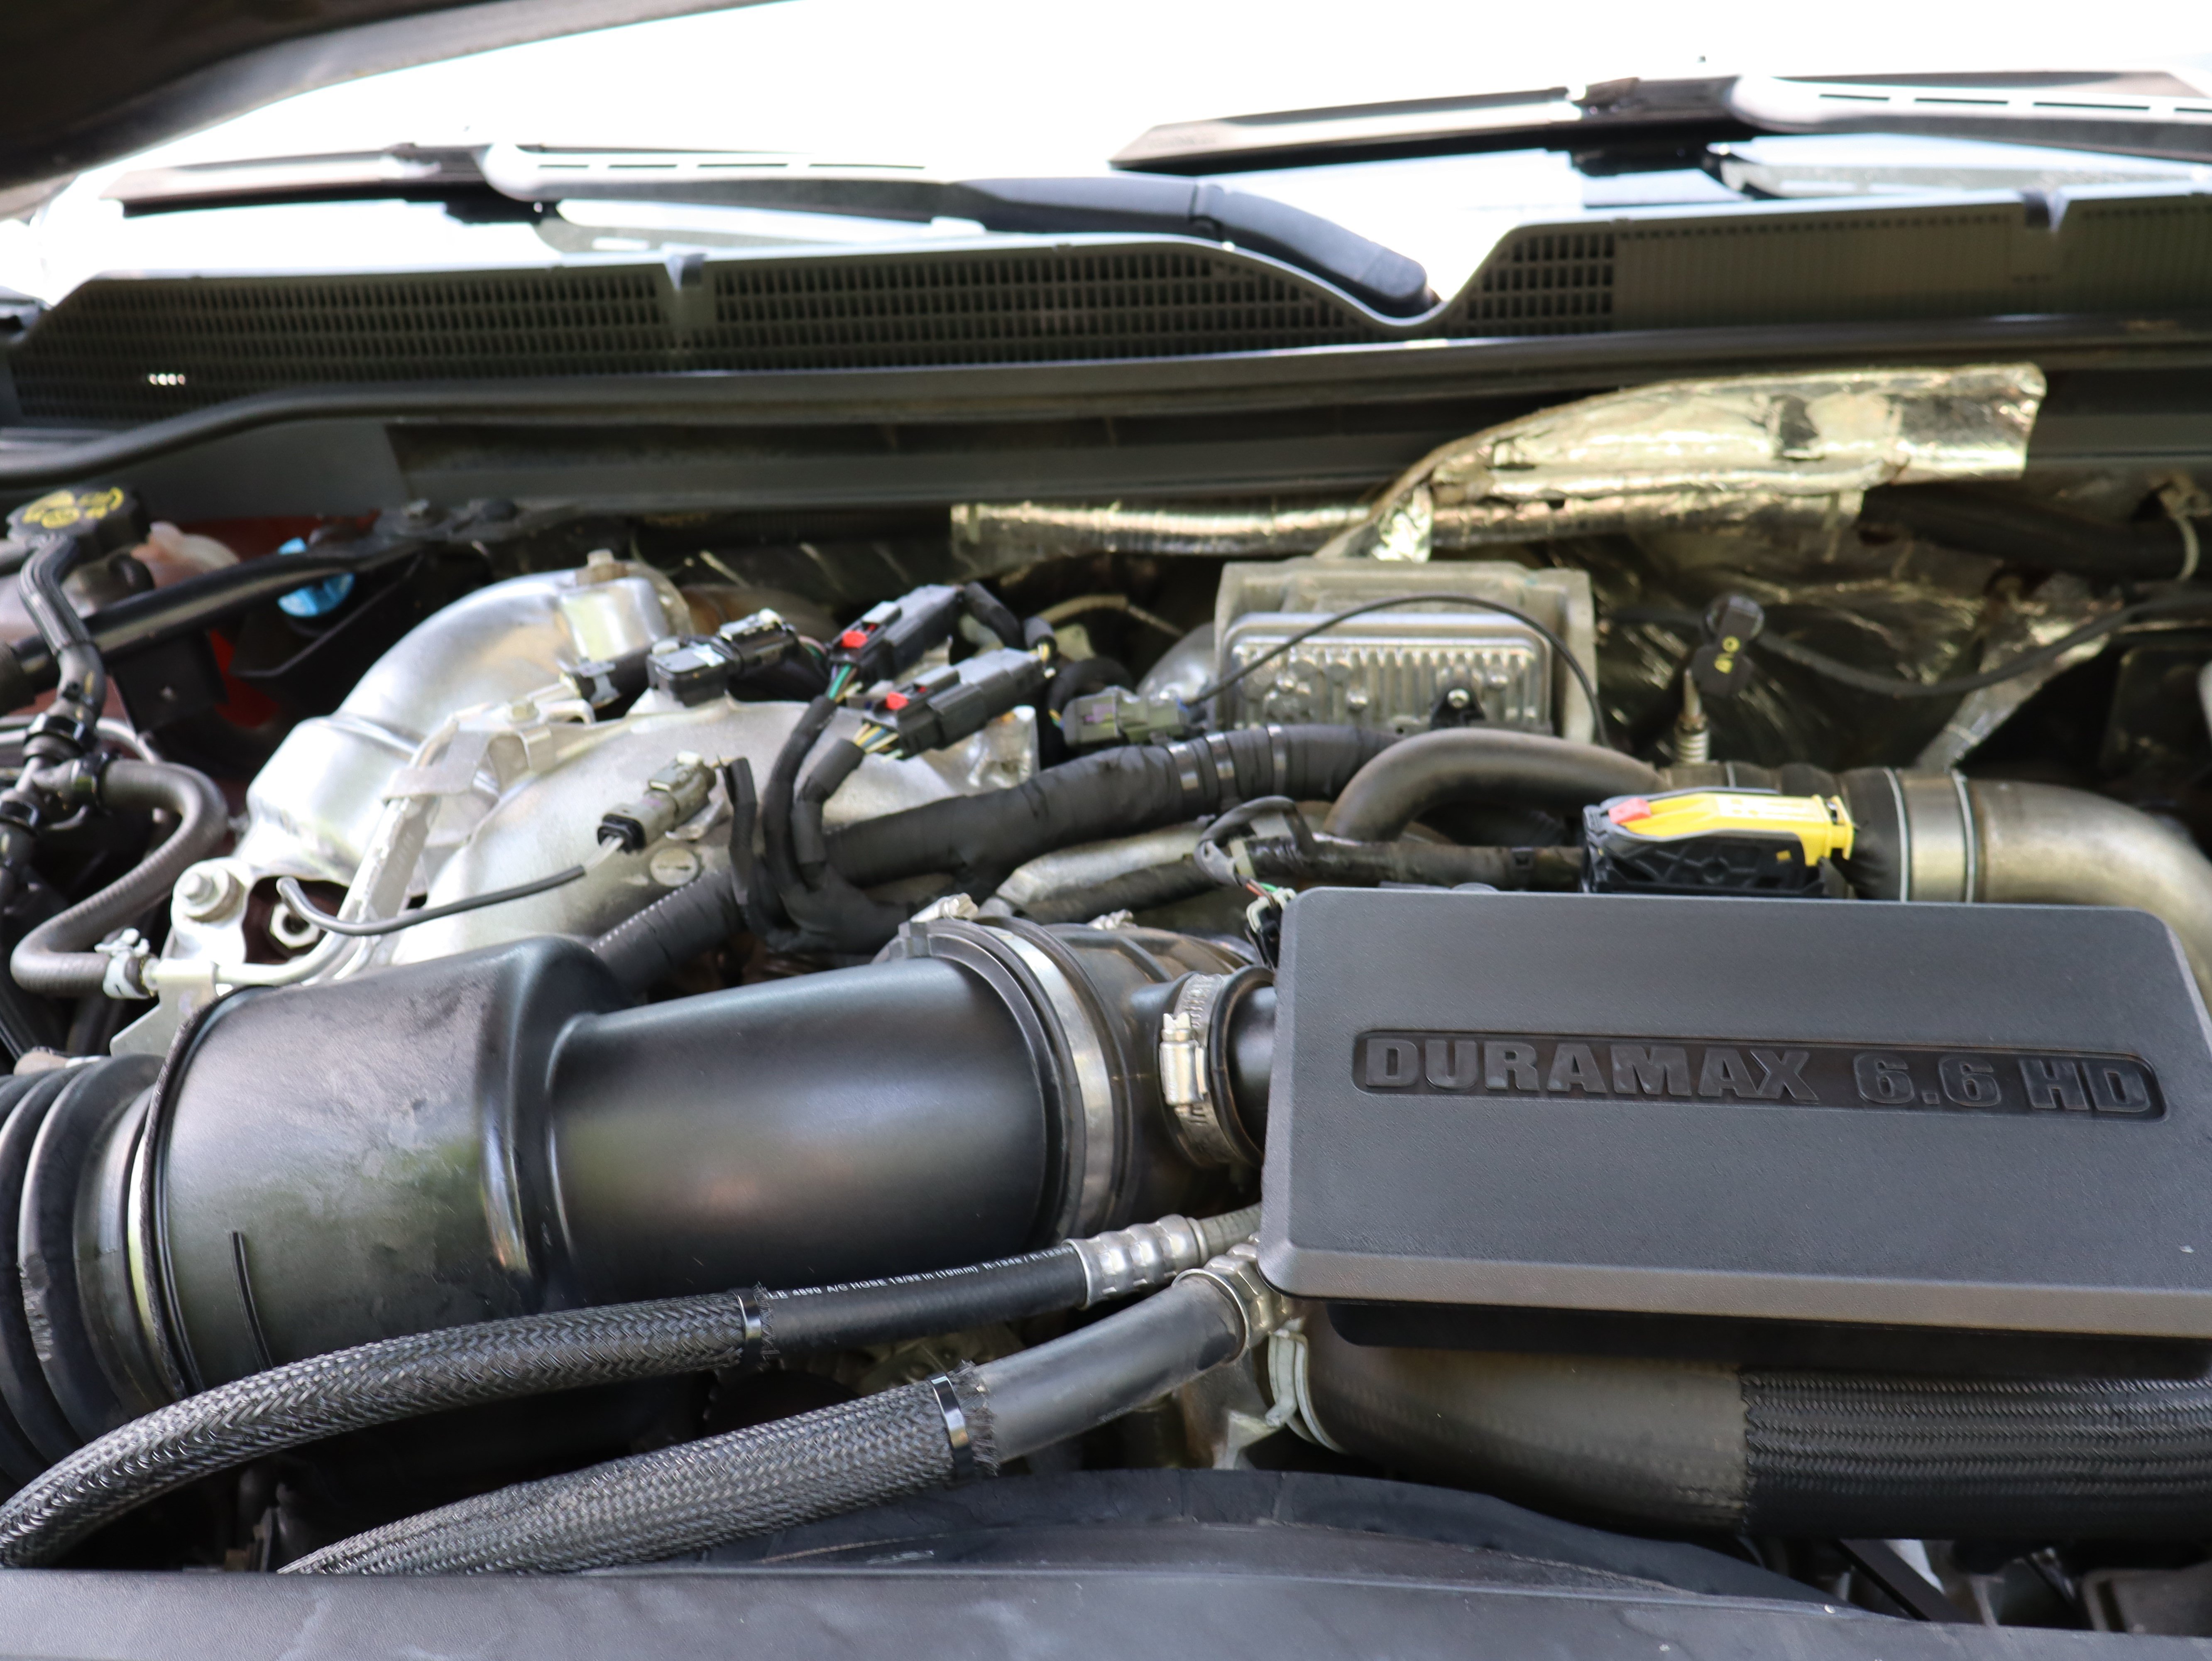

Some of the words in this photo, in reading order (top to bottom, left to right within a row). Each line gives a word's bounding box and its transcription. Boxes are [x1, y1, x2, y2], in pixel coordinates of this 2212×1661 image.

[1365, 1038, 1819, 1105] DURAMAX
[1852, 1052, 2002, 1107] 6.6
[2018, 1058, 2151, 1113] HD
[827, 1284, 848, 1293] A/C
[850, 1279, 888, 1290] HOSE
[935, 1265, 979, 1279] (10mm)
